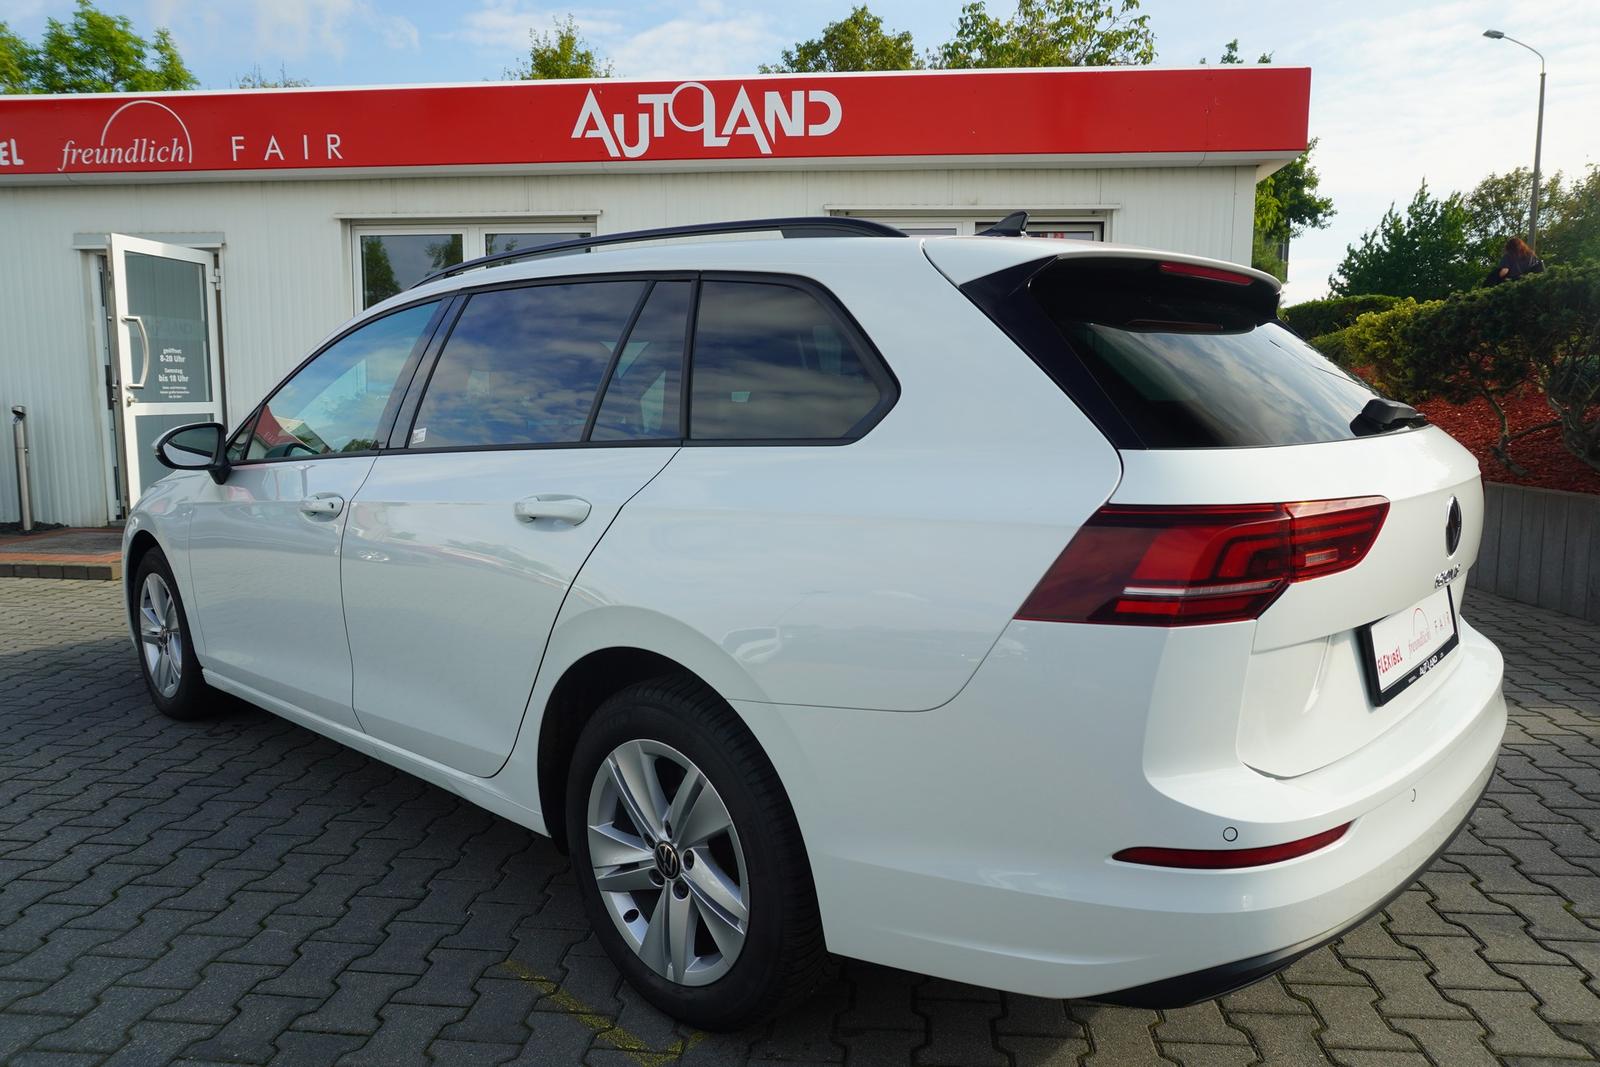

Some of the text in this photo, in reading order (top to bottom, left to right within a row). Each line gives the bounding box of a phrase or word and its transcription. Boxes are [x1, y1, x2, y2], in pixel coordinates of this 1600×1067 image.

[571, 82, 842, 158] AUTOLAND
[57, 137, 185, 171] freundlich
[231, 134, 344, 161] FAIR
[174, 354, 186, 363] Uhr
[158, 374, 168, 382] bis
[177, 374, 189, 382] Uhr
